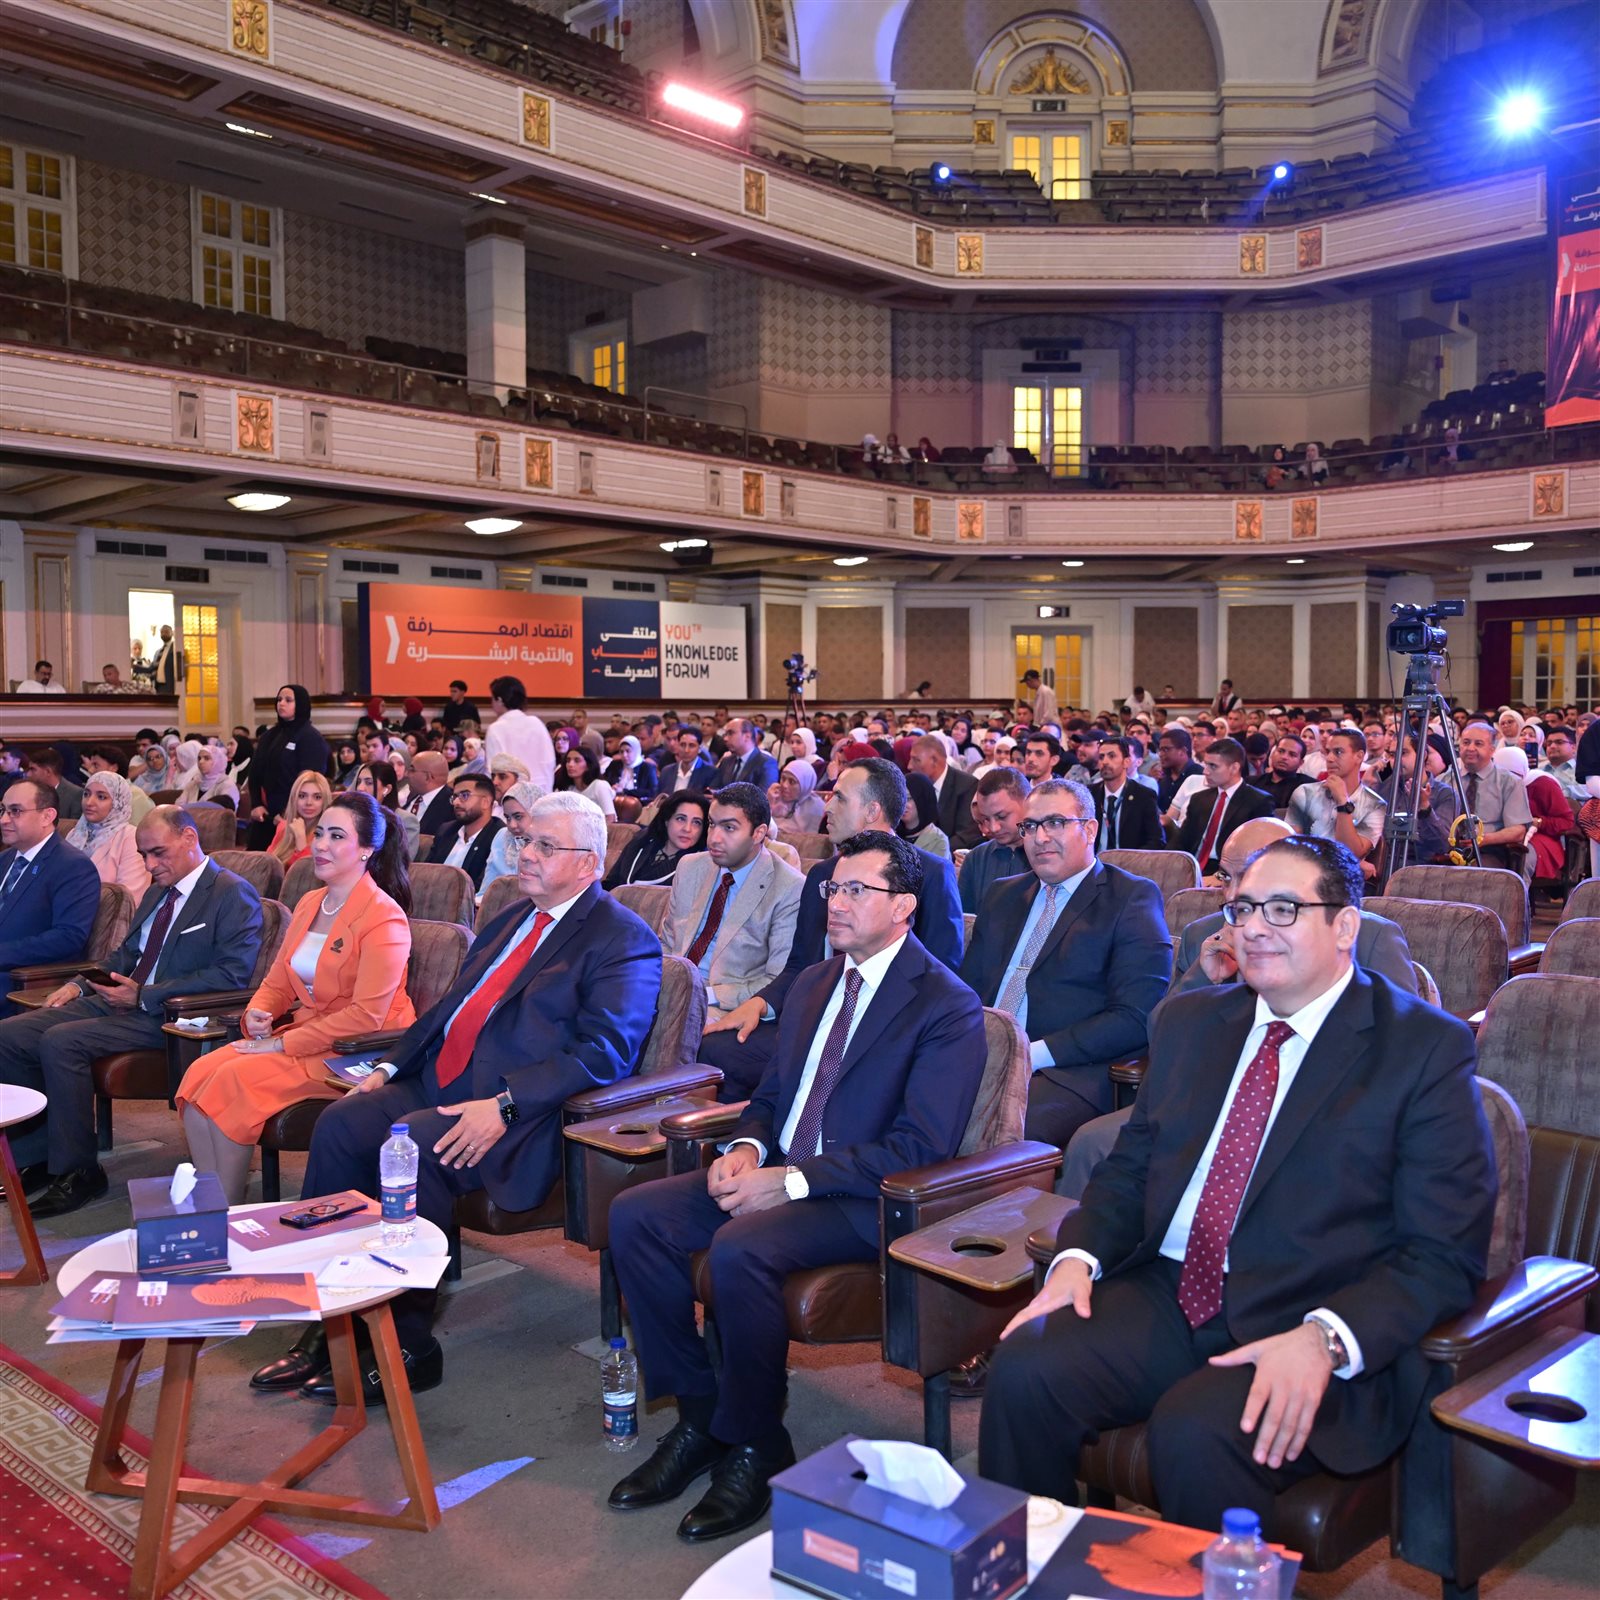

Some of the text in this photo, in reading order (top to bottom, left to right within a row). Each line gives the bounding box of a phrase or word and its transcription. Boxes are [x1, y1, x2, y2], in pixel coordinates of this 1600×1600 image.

[531, 623, 573, 639] اقتصاد
[520, 645, 573, 666] والتنمية
[665, 644, 738, 661] KNOWLEDGE
[665, 662, 709, 679] FORUM
